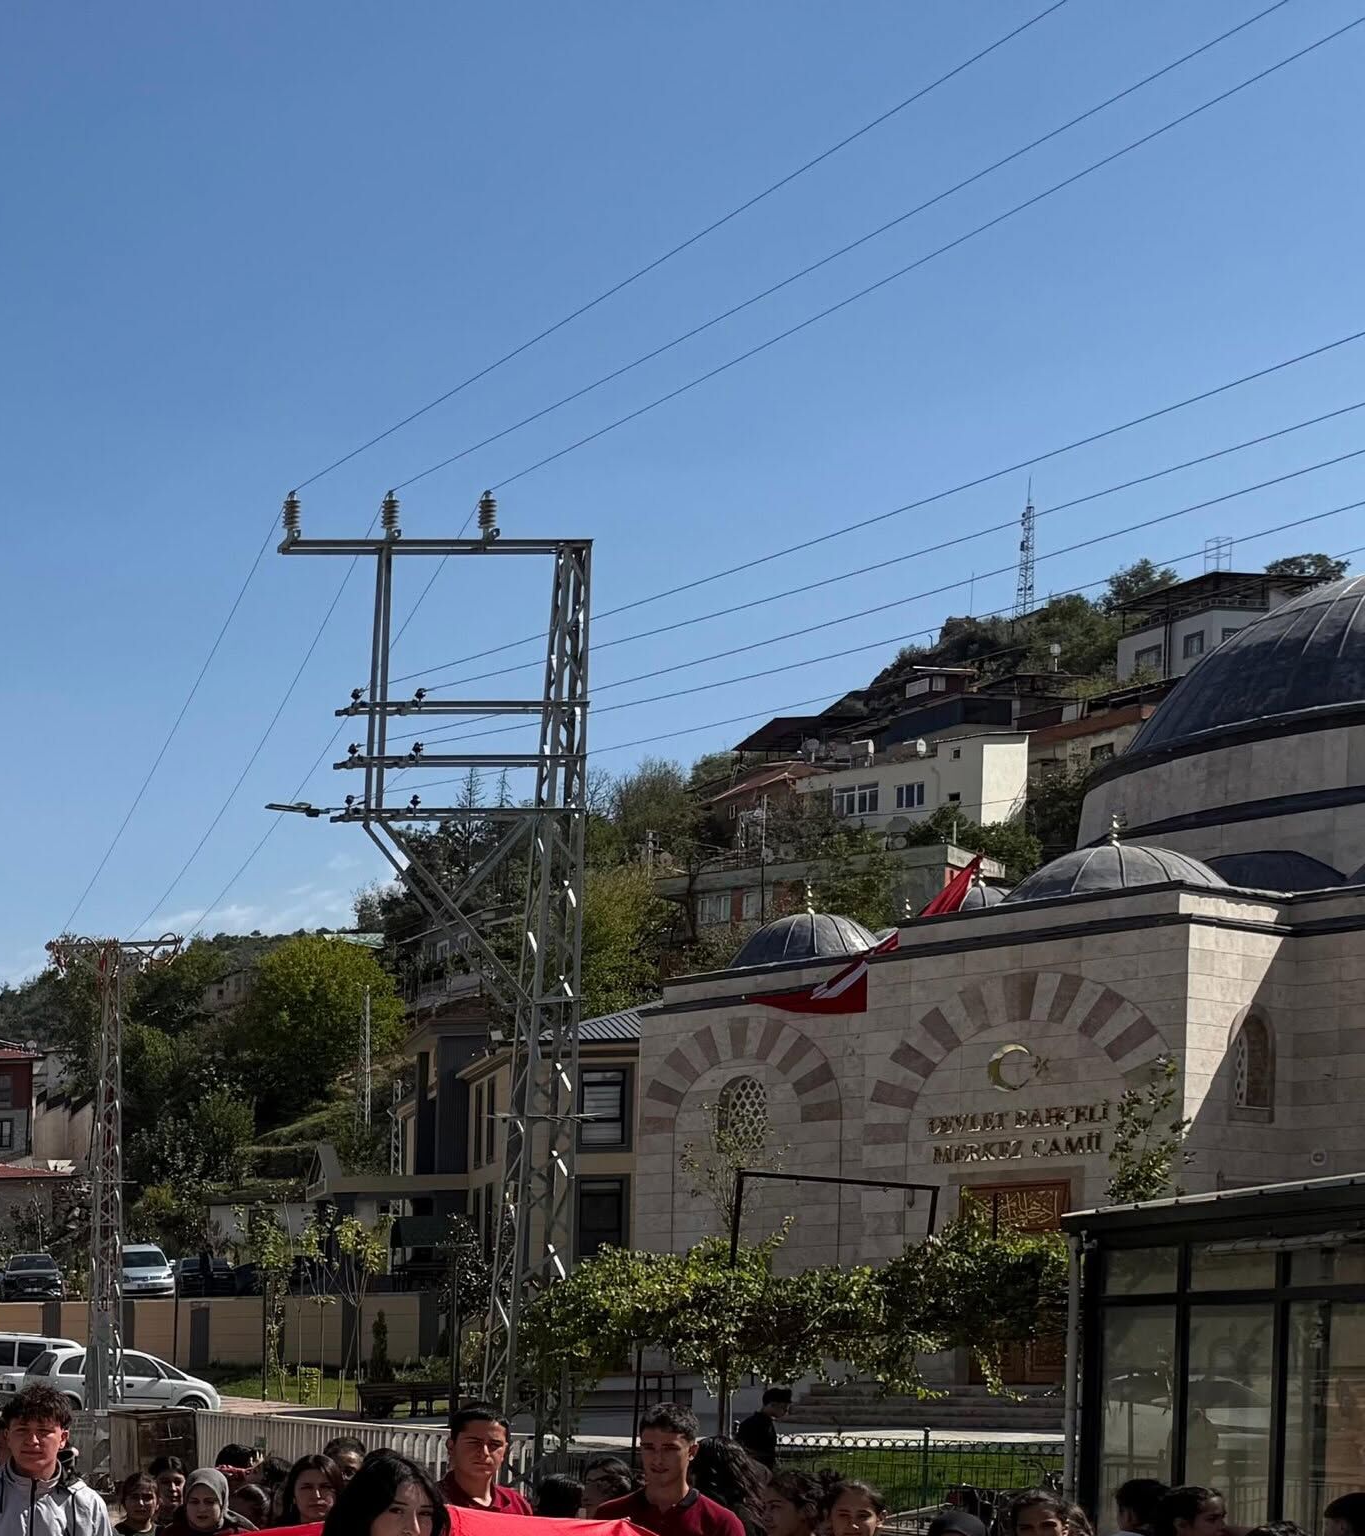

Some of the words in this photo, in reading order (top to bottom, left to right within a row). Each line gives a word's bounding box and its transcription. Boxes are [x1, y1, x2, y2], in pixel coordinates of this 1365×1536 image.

[927, 1112, 1008, 1136] DEVLET
[1014, 1099, 1111, 1131] BAHÇELİ
[933, 1140, 1023, 1165] MERKEZ
[1032, 1131, 1103, 1158] CAMİİ
